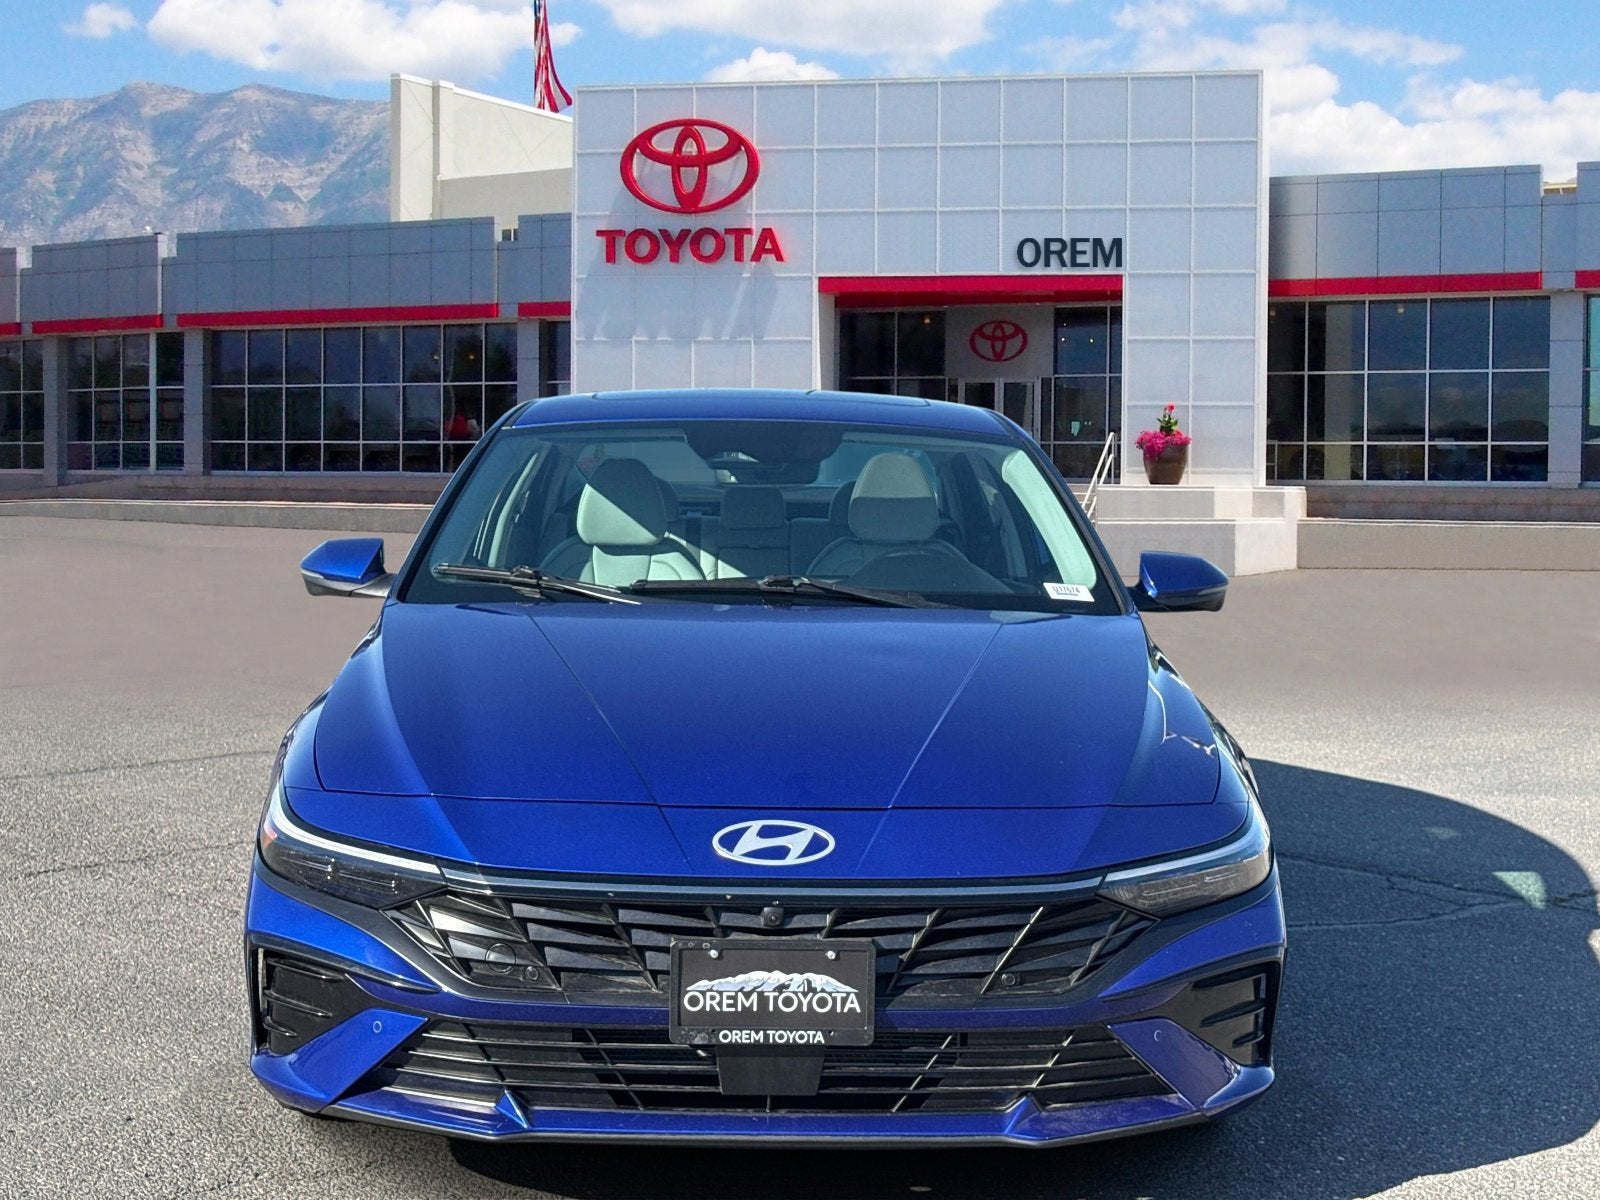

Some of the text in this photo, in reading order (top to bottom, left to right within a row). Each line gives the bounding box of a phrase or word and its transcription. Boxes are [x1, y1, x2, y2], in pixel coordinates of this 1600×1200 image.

[596, 227, 784, 264] TOYOTA
[1017, 237, 1122, 267] OREM
[683, 991, 861, 1013] OREM TOYOTA
[718, 1030, 825, 1044] OREM TOYOTA
